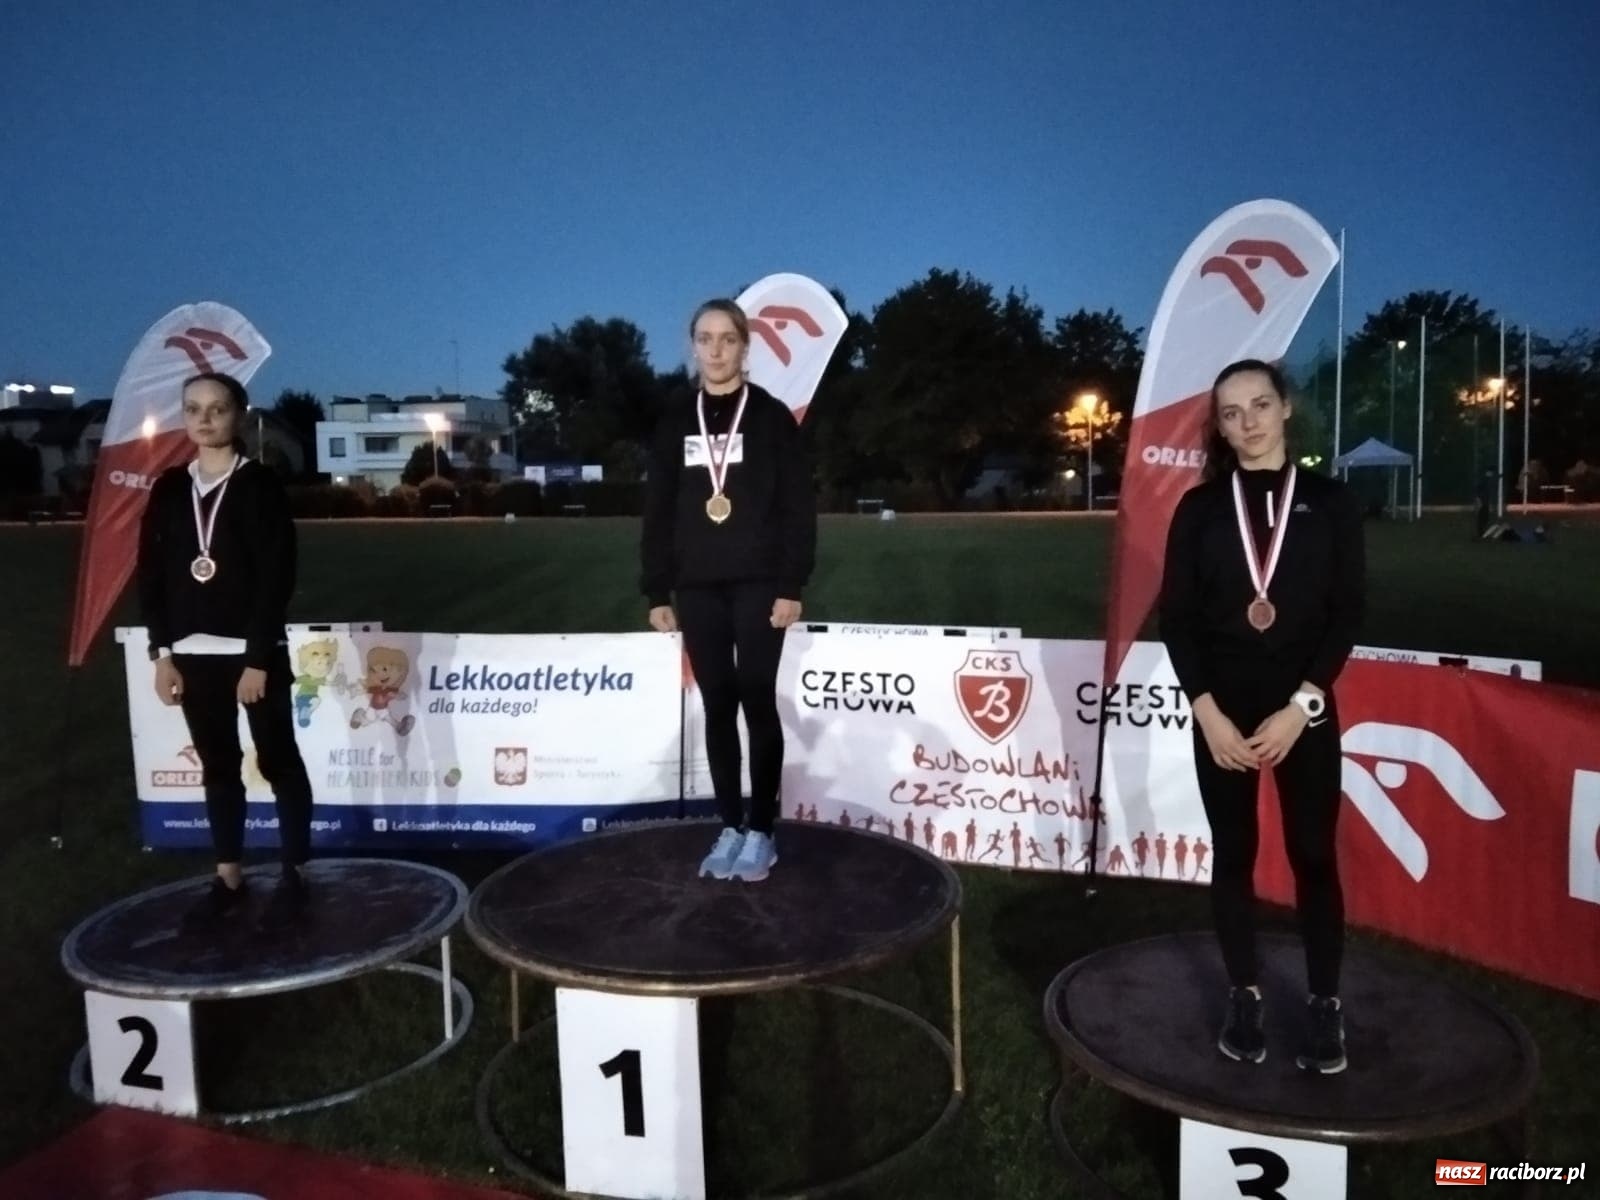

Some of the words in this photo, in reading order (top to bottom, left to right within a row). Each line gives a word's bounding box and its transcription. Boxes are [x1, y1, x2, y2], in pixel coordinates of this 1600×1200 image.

[428, 664, 634, 696] Lekkoatletyka
[971, 656, 1012, 672] CKS
[428, 697, 455, 714] dla
[460, 698, 538, 718] każdego!
[973, 681, 1012, 723] B
[392, 820, 470, 832] Lekkoatletyka
[472, 820, 489, 832] dla
[491, 819, 536, 833] każdego
[118, 1016, 163, 1090] 2
[600, 1049, 645, 1138] 1
[1228, 1147, 1290, 1200] 3
